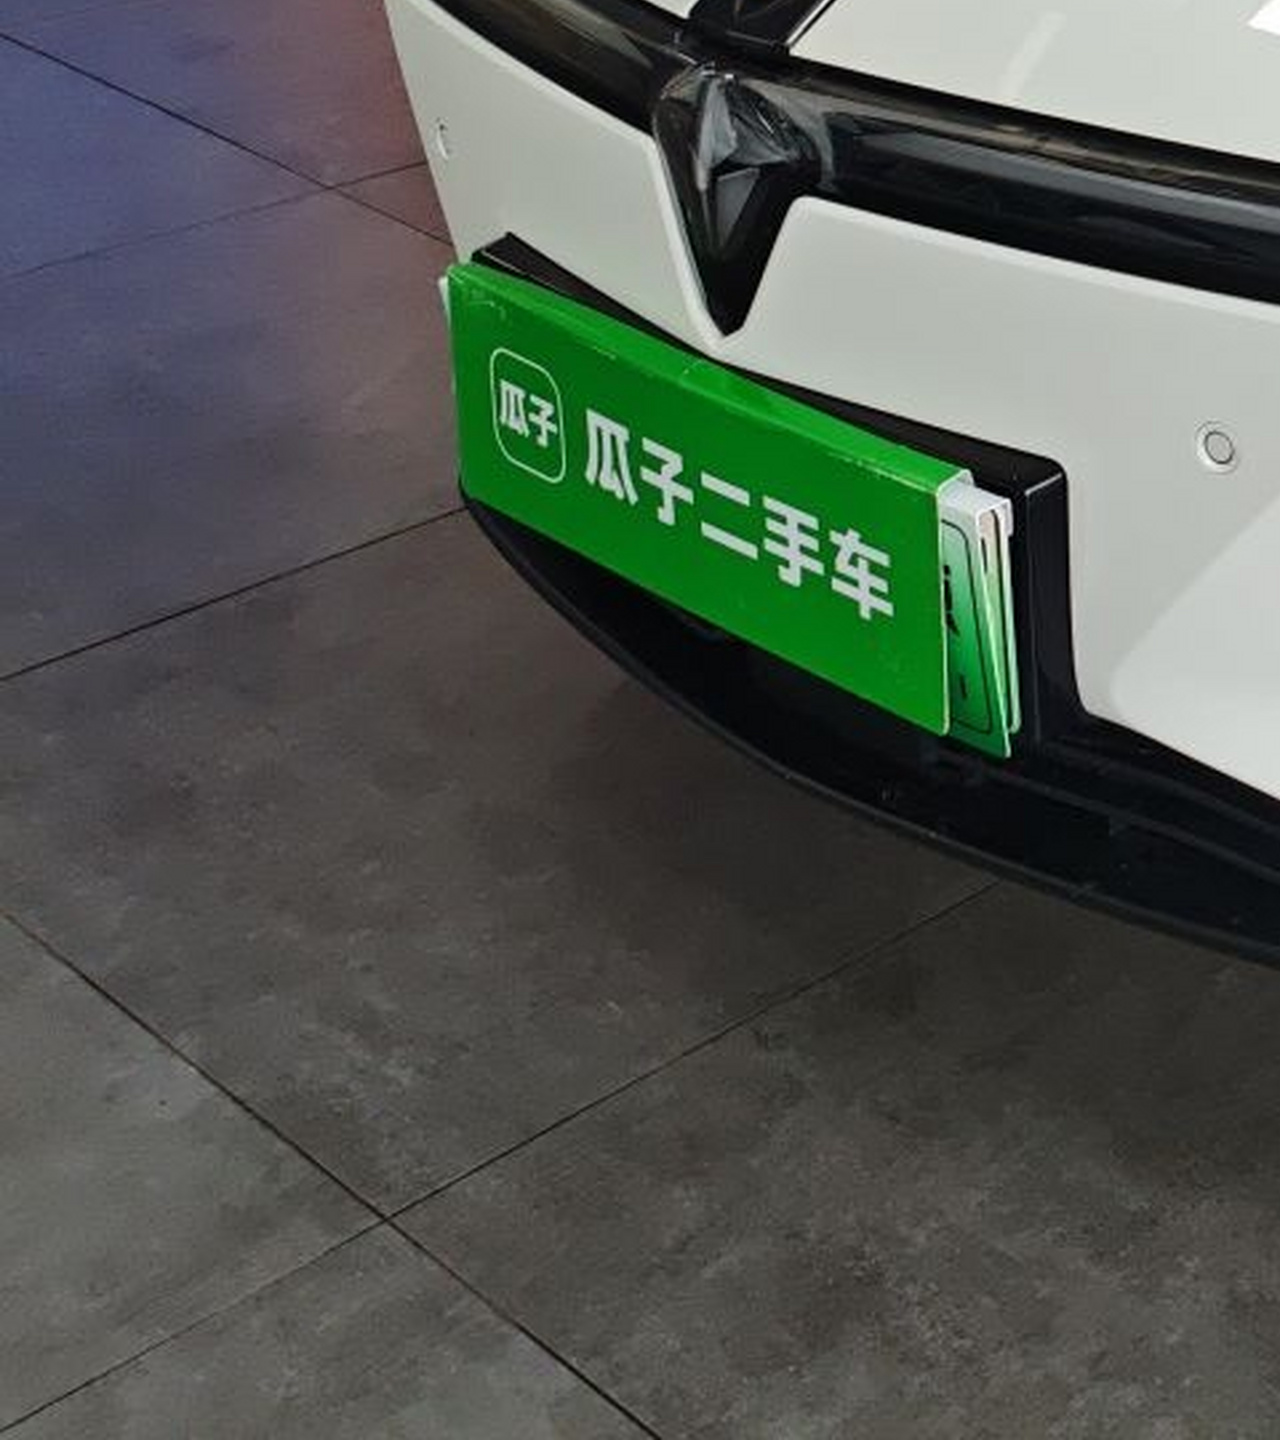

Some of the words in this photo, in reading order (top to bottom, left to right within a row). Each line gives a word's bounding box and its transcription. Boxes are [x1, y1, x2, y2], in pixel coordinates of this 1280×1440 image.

[500, 379, 558, 447] 瓜子
[586, 409, 893, 620] 瓜子二手车
